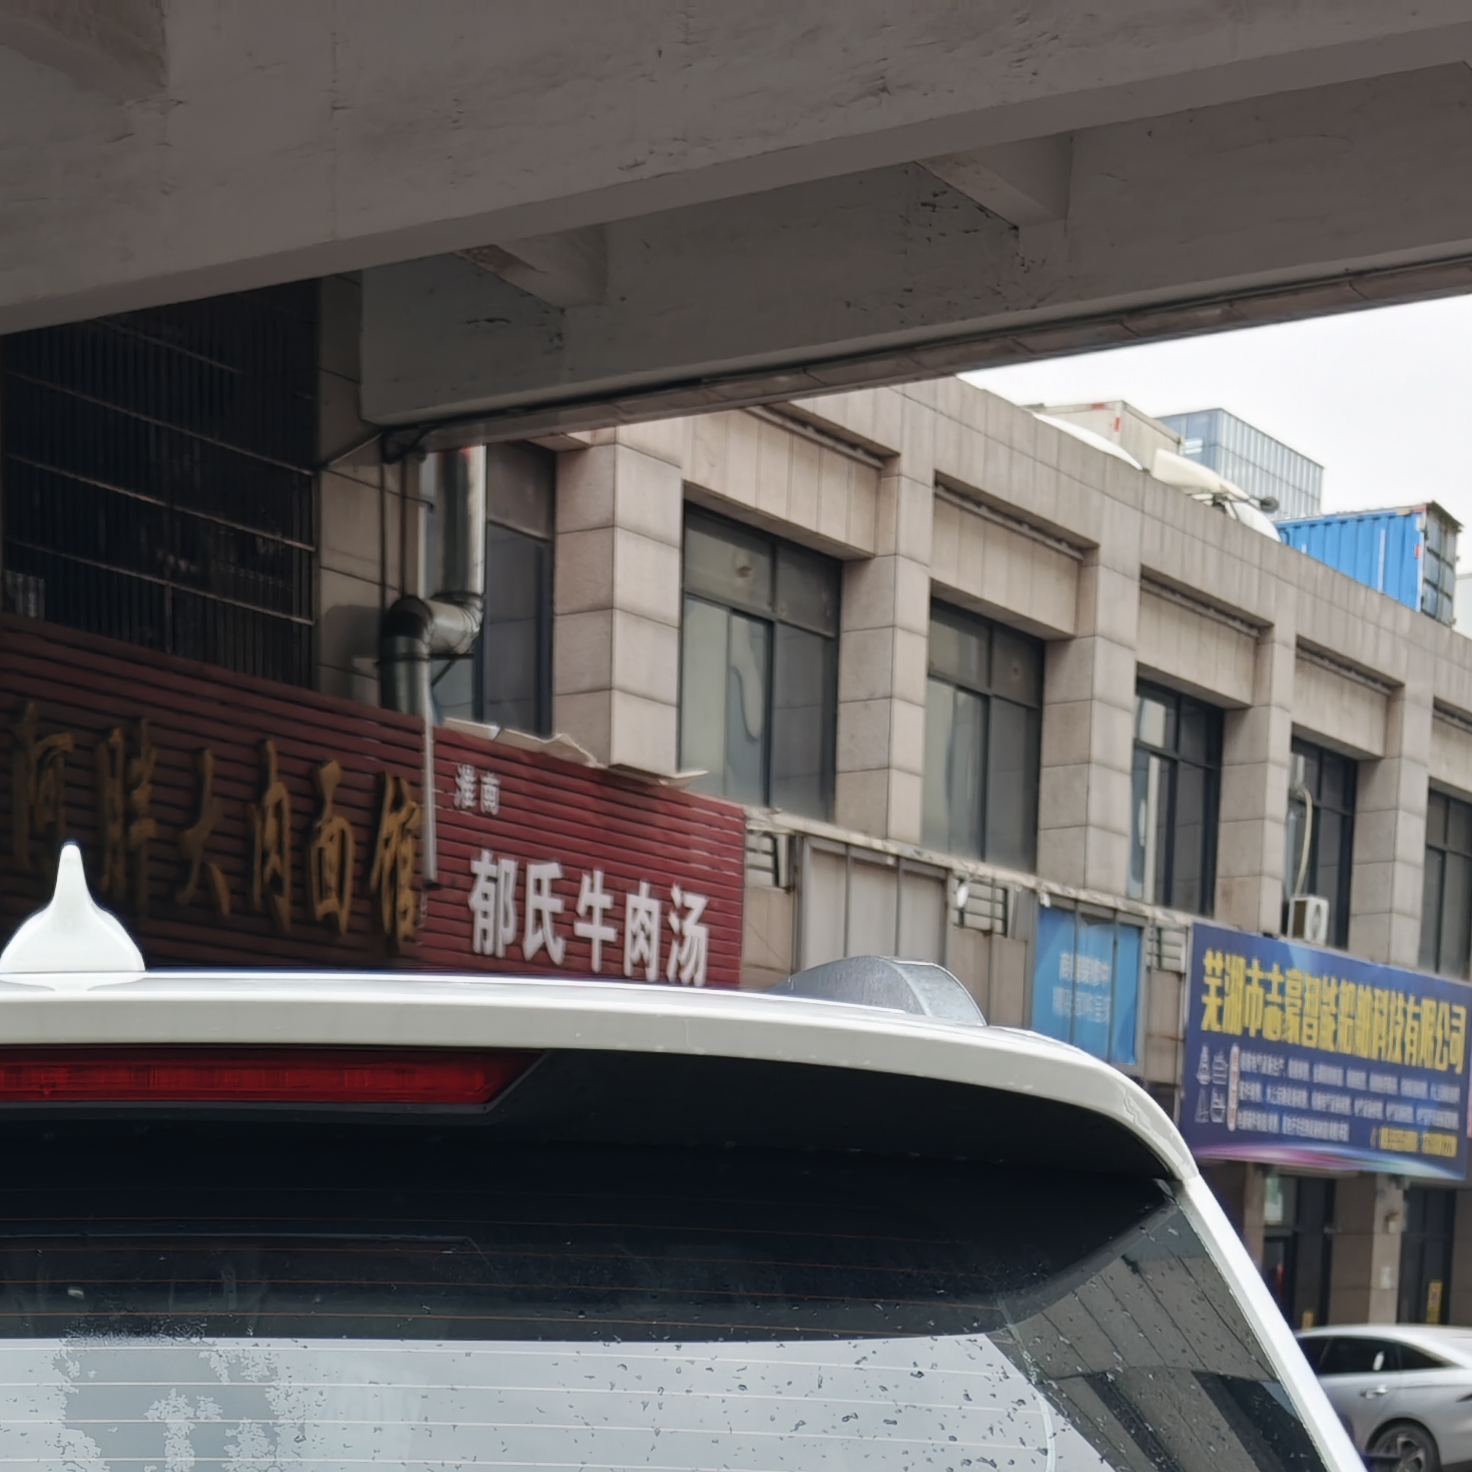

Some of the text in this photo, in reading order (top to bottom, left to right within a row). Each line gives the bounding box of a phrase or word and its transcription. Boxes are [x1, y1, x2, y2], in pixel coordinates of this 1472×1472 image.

[469, 849, 708, 986] 郁氏牛肉汤
